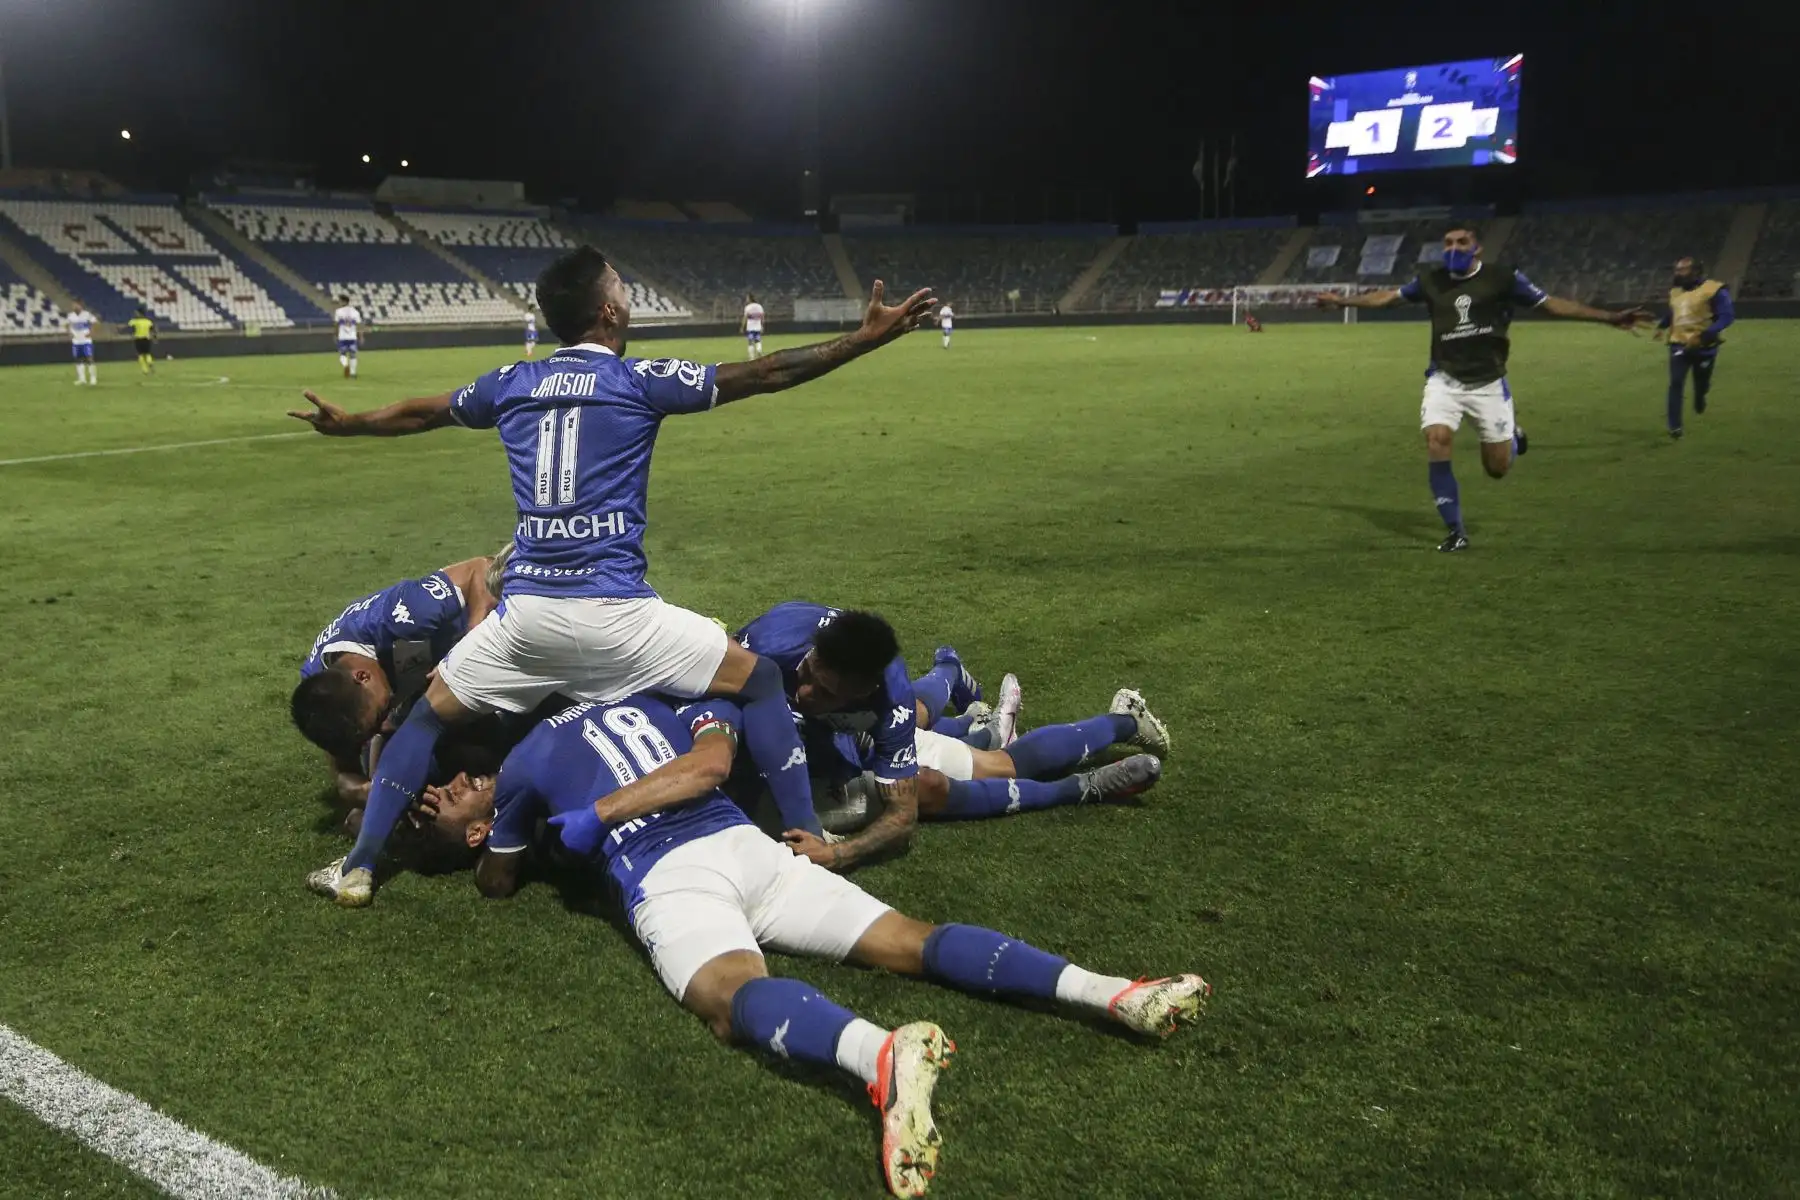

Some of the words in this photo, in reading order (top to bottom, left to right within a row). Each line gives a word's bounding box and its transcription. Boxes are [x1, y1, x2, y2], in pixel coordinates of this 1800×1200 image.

[1365, 122, 1381, 143] 1
[1432, 116, 1454, 139] 2
[531, 372, 597, 398] JANSON
[535, 406, 581, 507] 11
[540, 472, 548, 494] RUS
[564, 469, 572, 491] RUS
[516, 511, 626, 539] HITACHI
[582, 706, 678, 787] 18
[658, 740, 673, 760] RUS
[616, 761, 632, 782] RUS
